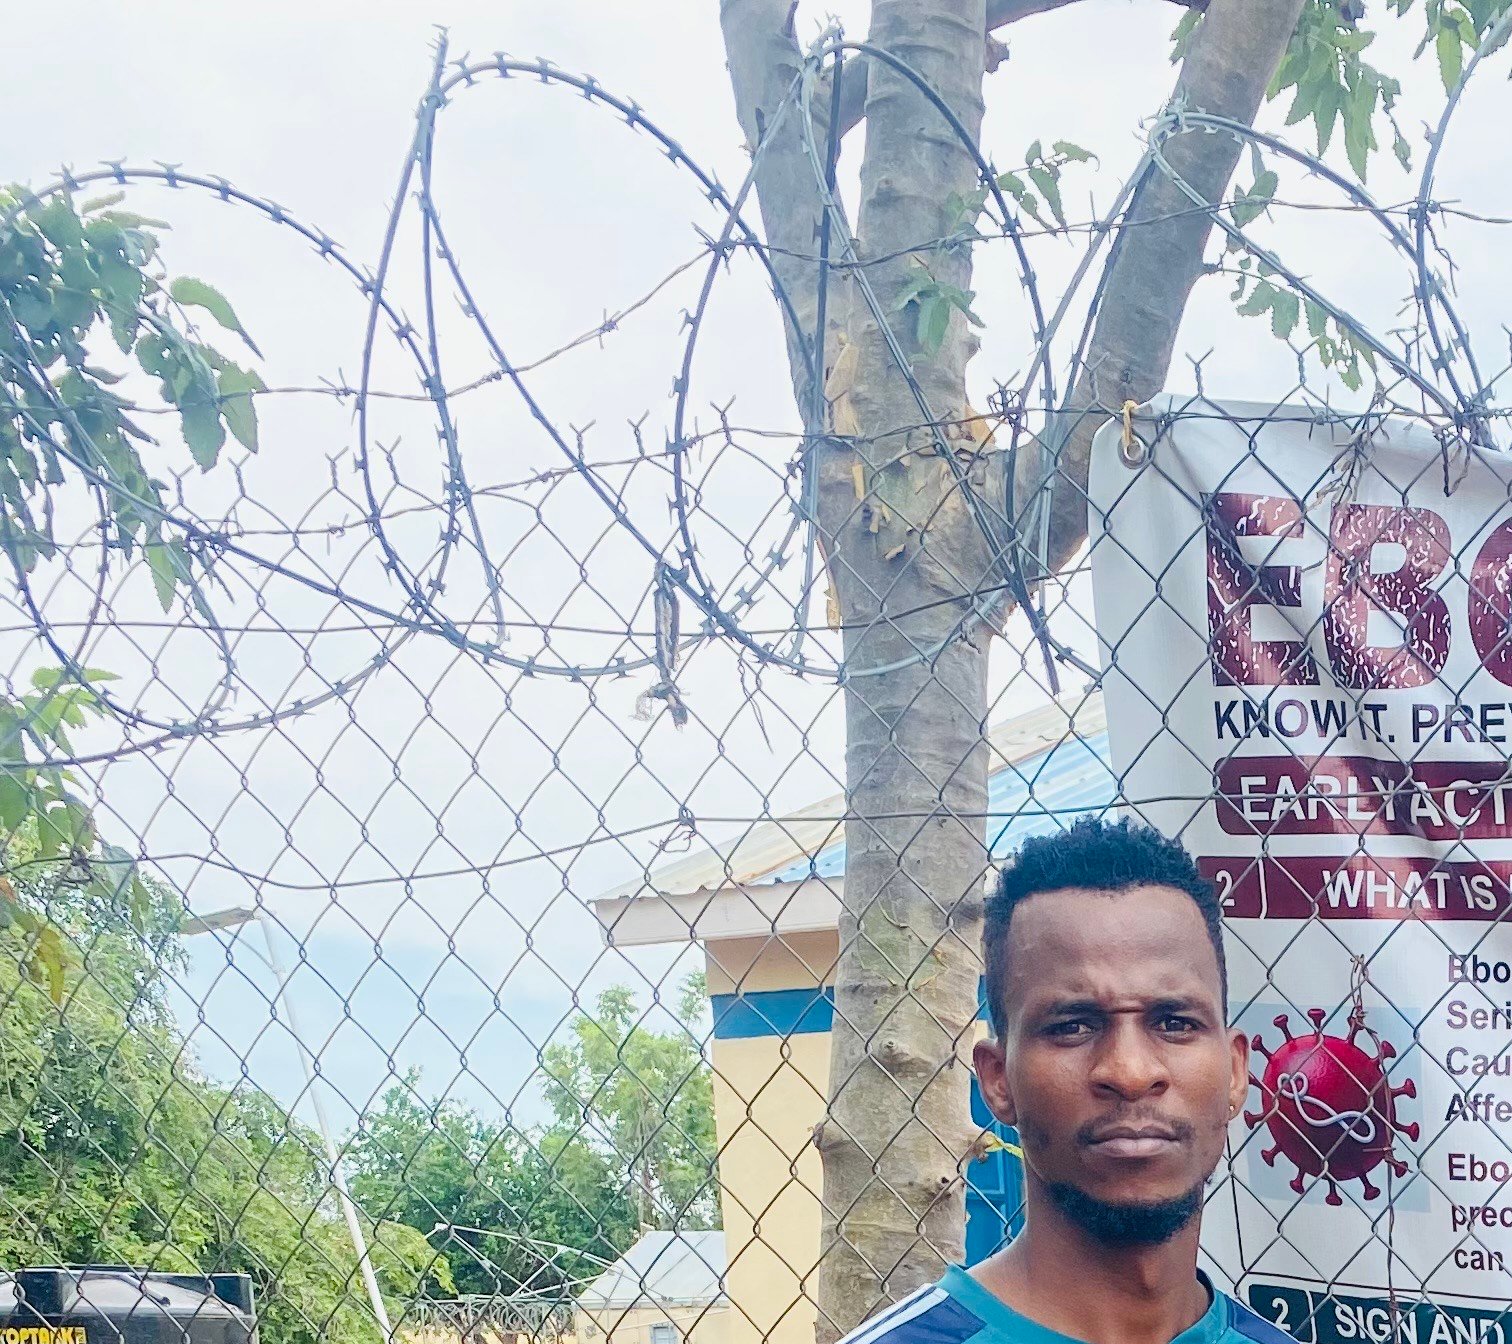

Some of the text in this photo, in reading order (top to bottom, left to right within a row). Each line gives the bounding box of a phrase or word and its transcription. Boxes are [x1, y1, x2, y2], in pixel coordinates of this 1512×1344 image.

[1214, 697, 1351, 740] KNOW
[1351, 699, 1394, 742] IT.
[1240, 775, 1401, 823] EARLY
[1215, 870, 1236, 908] 2
[1323, 870, 1452, 909] WHAT
[1462, 875, 1499, 911] IS
[1454, 1250, 1504, 1273] can
[1271, 1298, 1290, 1331] 2
